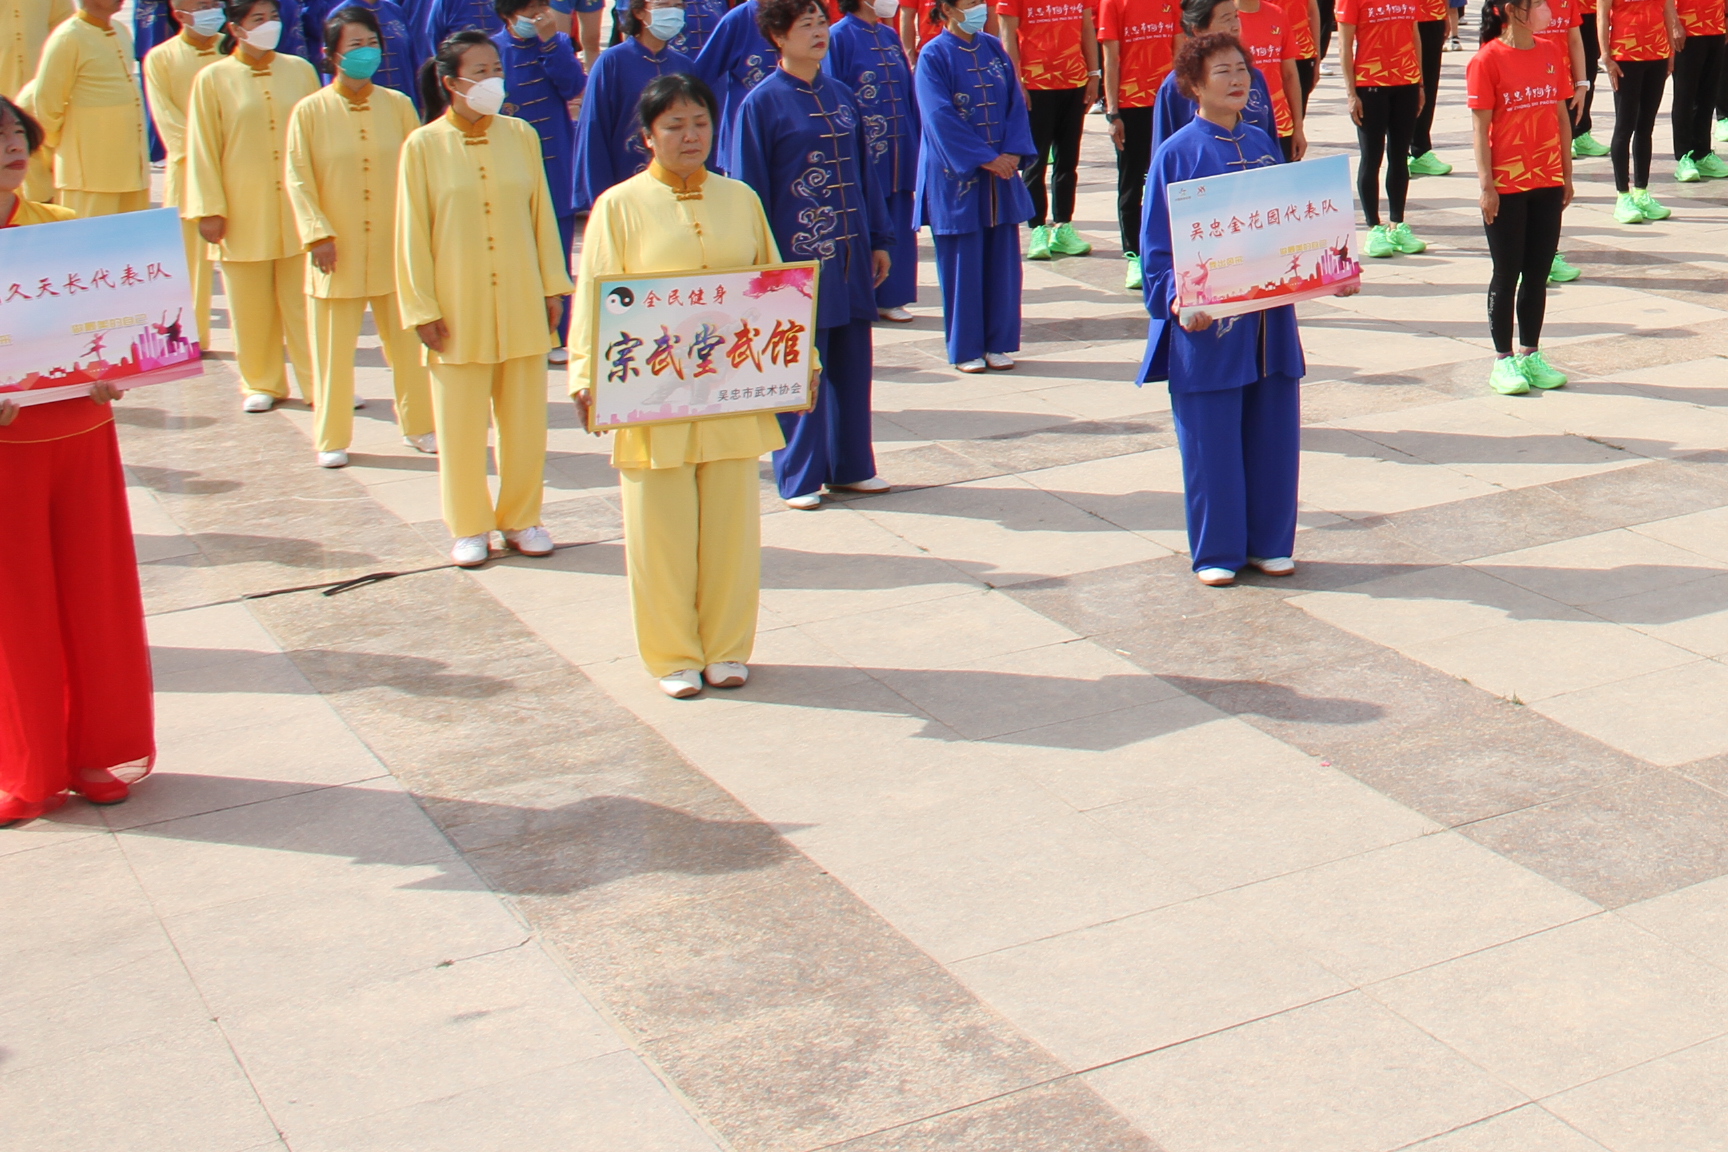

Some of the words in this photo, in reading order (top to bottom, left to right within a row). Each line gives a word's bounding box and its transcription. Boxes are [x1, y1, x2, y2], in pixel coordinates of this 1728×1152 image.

[1190, 199, 1339, 241] 吴忠金花园代表队
[0, 262, 172, 303] 久天长代表队
[643, 284, 727, 308] 全民健身
[605, 319, 807, 384] 宗武堂武馆
[717, 382, 803, 403] 吴忠市武术协会
